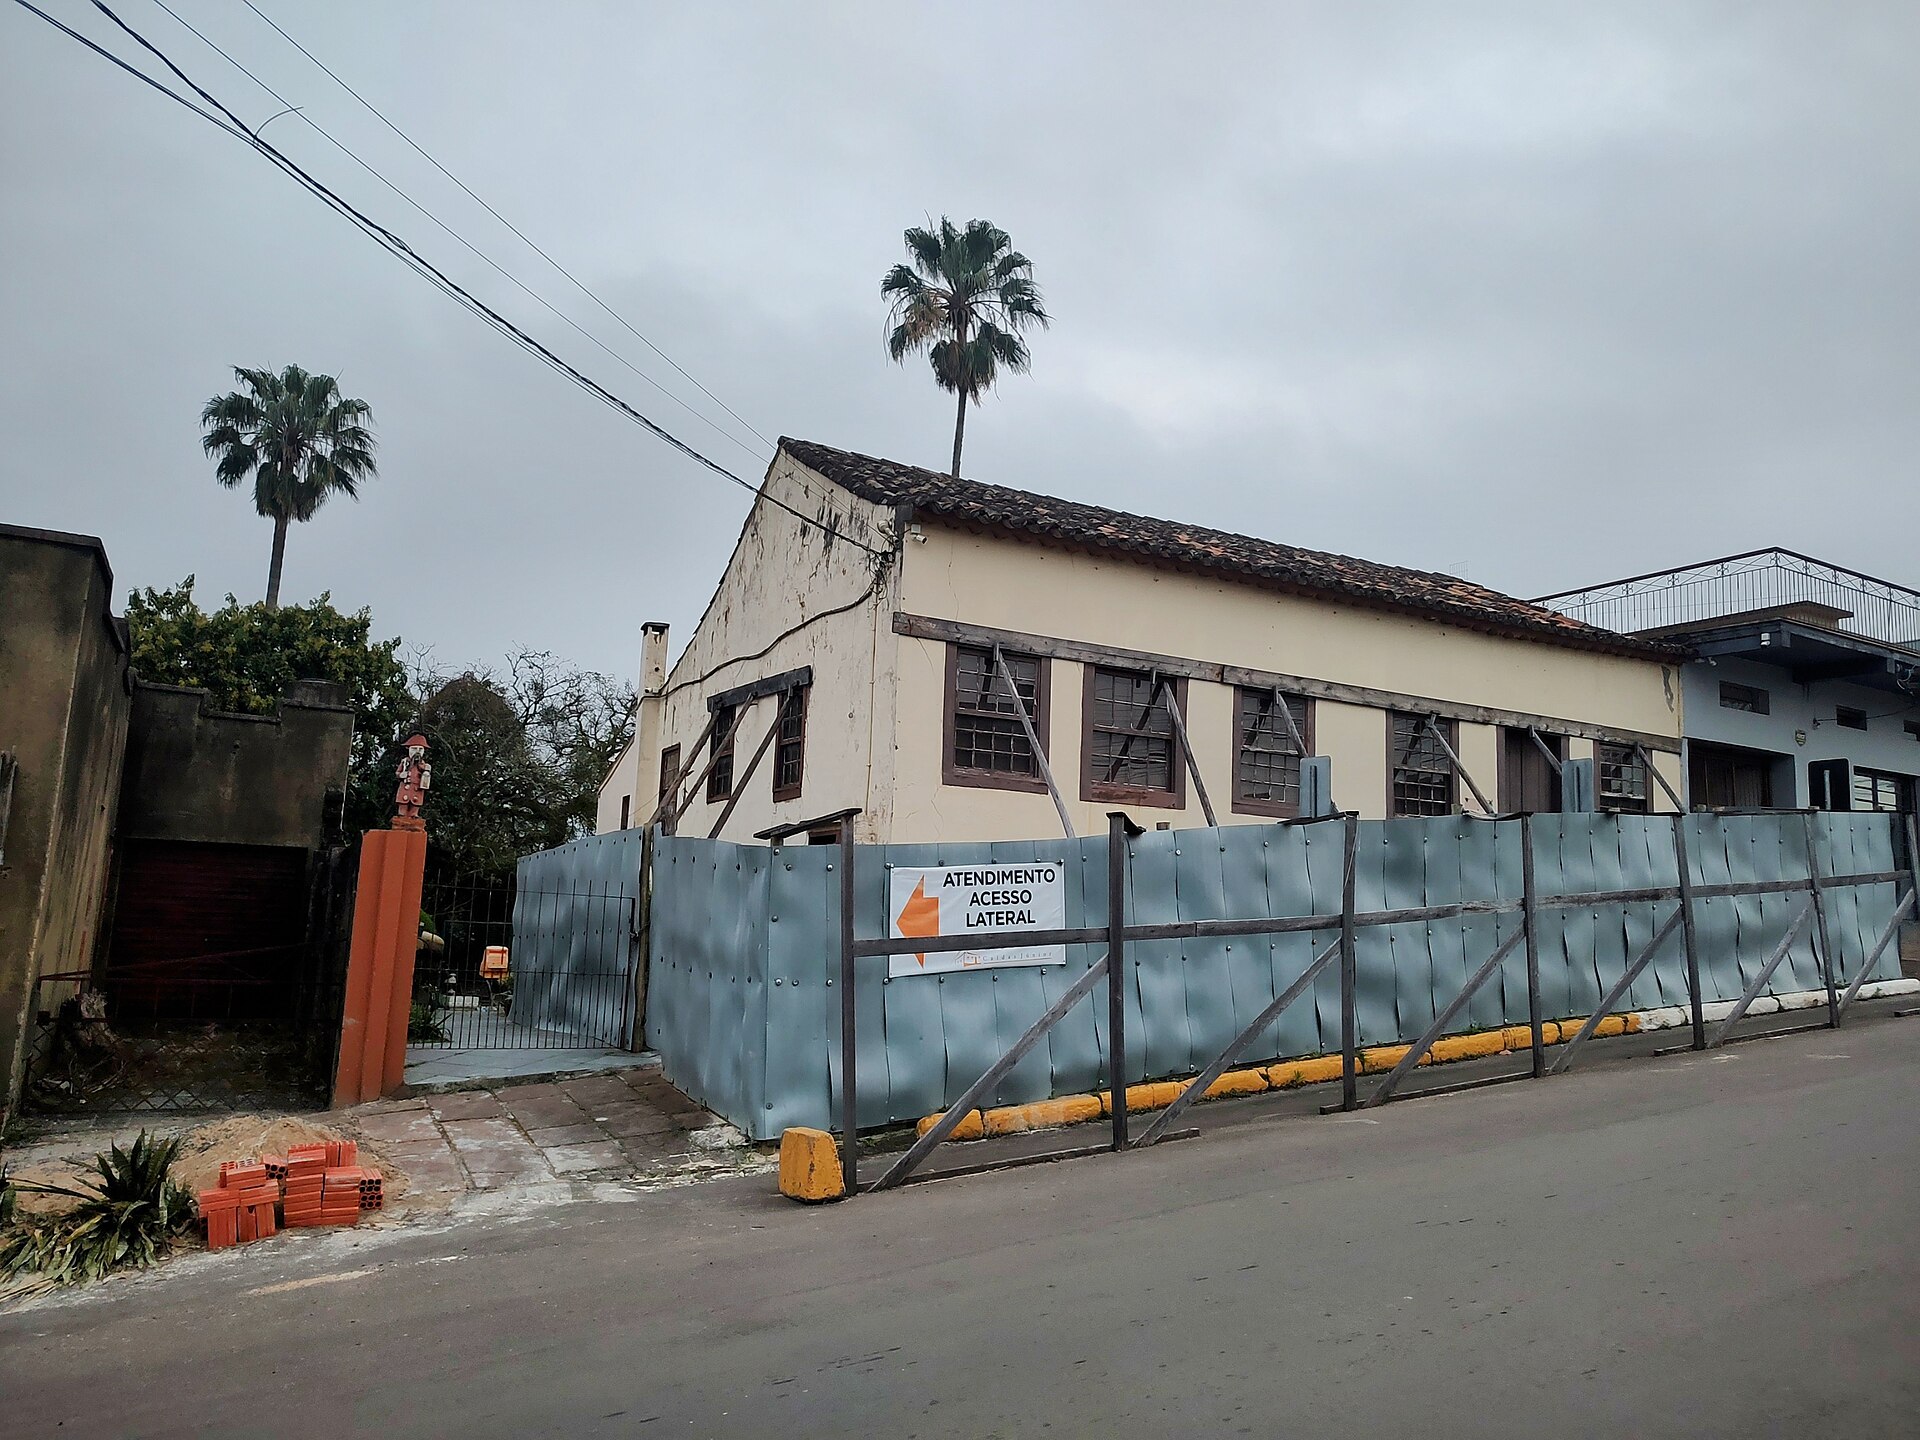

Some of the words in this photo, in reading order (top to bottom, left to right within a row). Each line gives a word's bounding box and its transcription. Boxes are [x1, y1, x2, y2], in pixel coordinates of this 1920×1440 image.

[943, 868, 1056, 887] ATENDIMENTO
[969, 890, 1032, 907] ACESSO
[966, 910, 1036, 927] LATERAL
